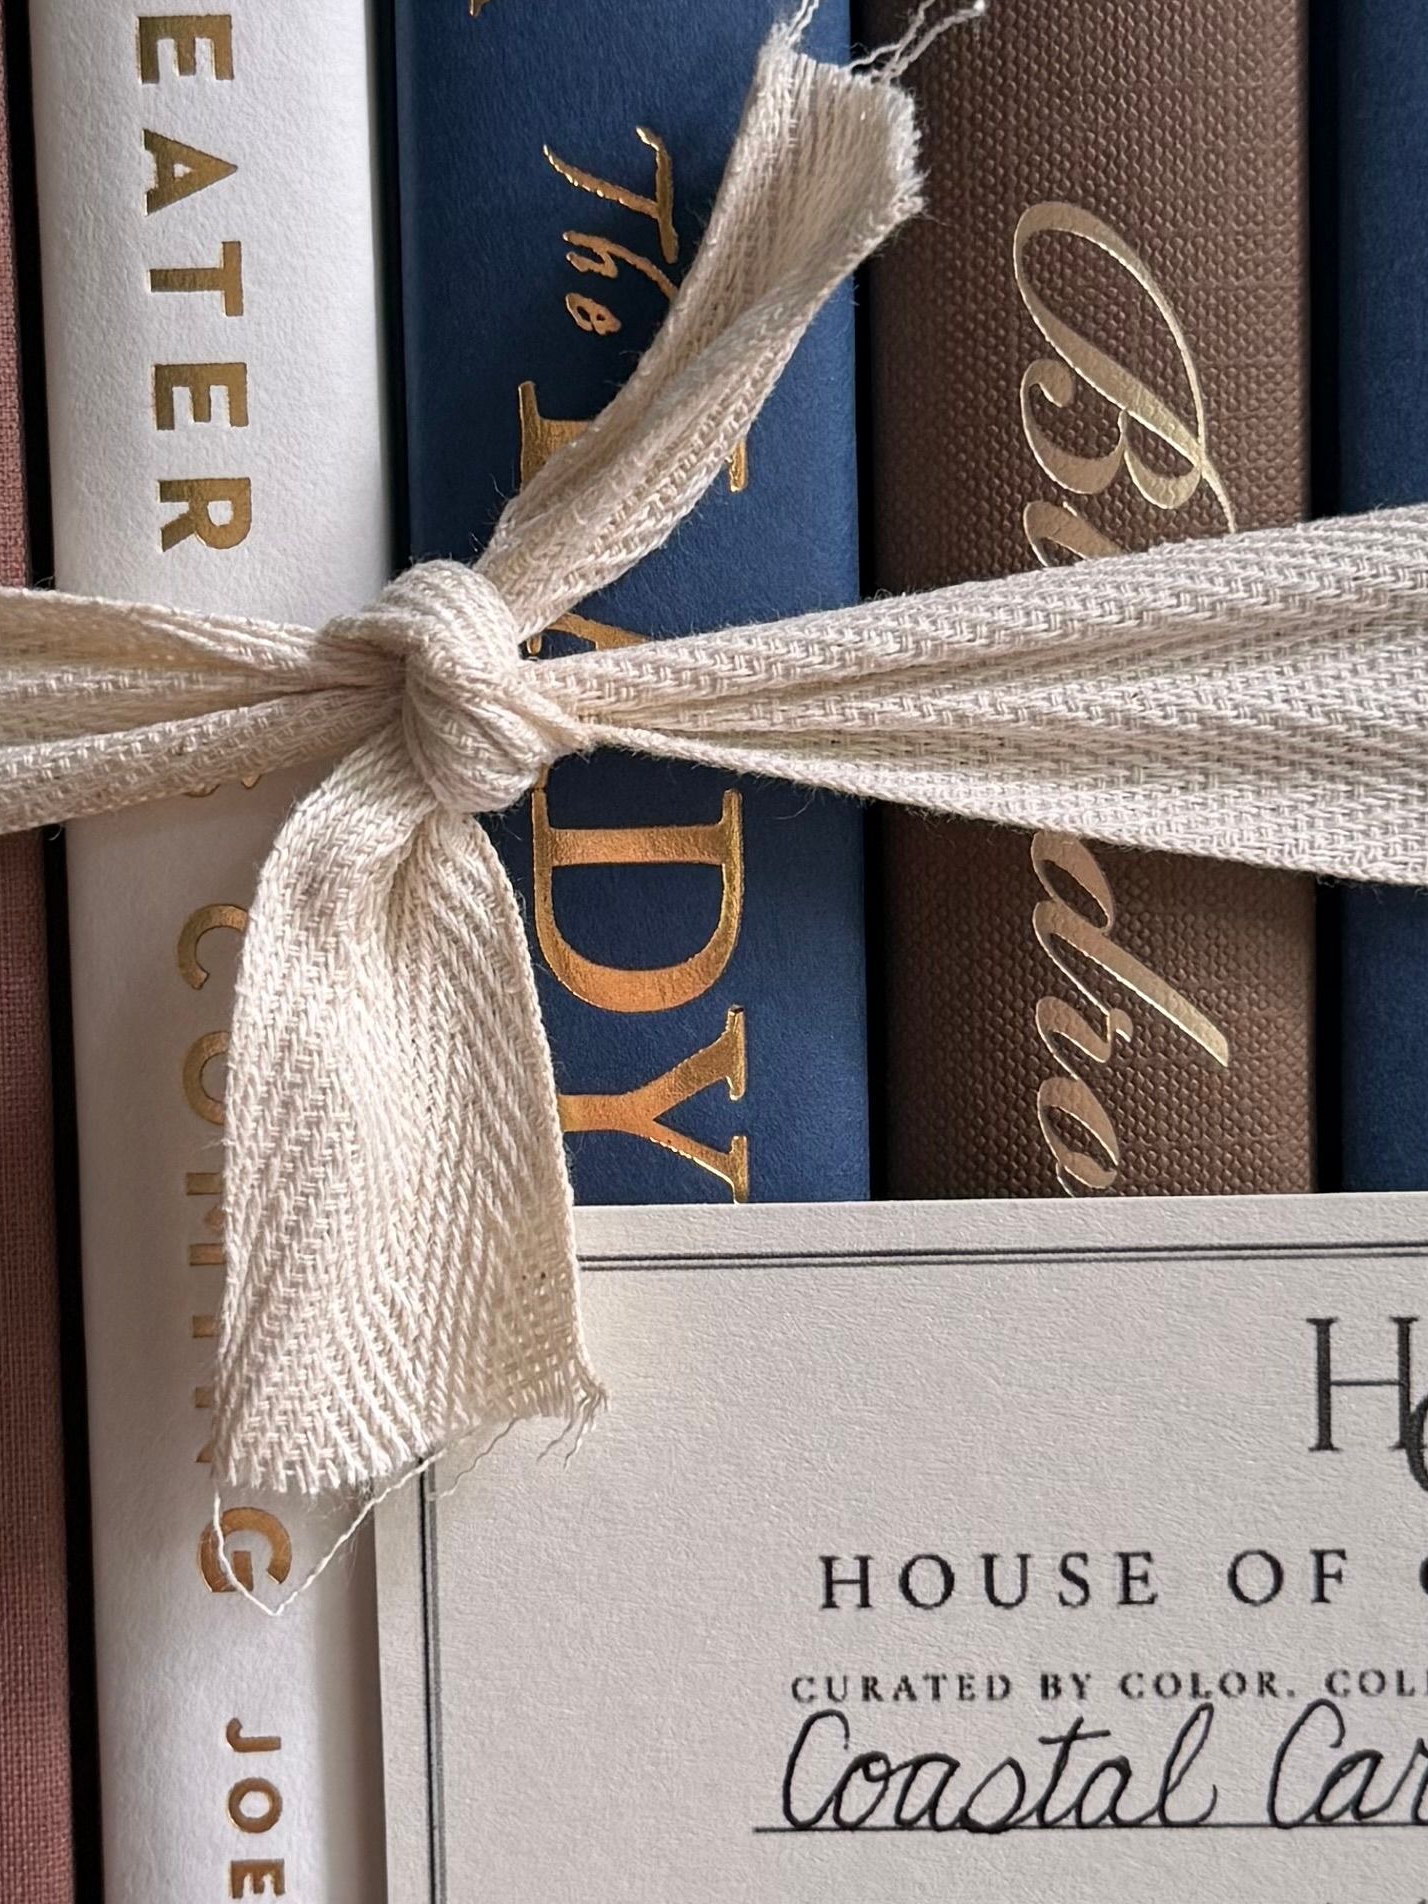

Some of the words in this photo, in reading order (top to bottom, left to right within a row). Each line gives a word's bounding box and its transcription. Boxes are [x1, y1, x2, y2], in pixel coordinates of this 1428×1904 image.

[543, 125, 680, 337] The
[817, 1551, 1160, 1610] HOUSE
[1226, 1547, 1348, 1606] OF
[789, 1671, 1013, 1704] CURATED
[1038, 1671, 1094, 1701] BY
[780, 1701, 1219, 1834] Coastal
